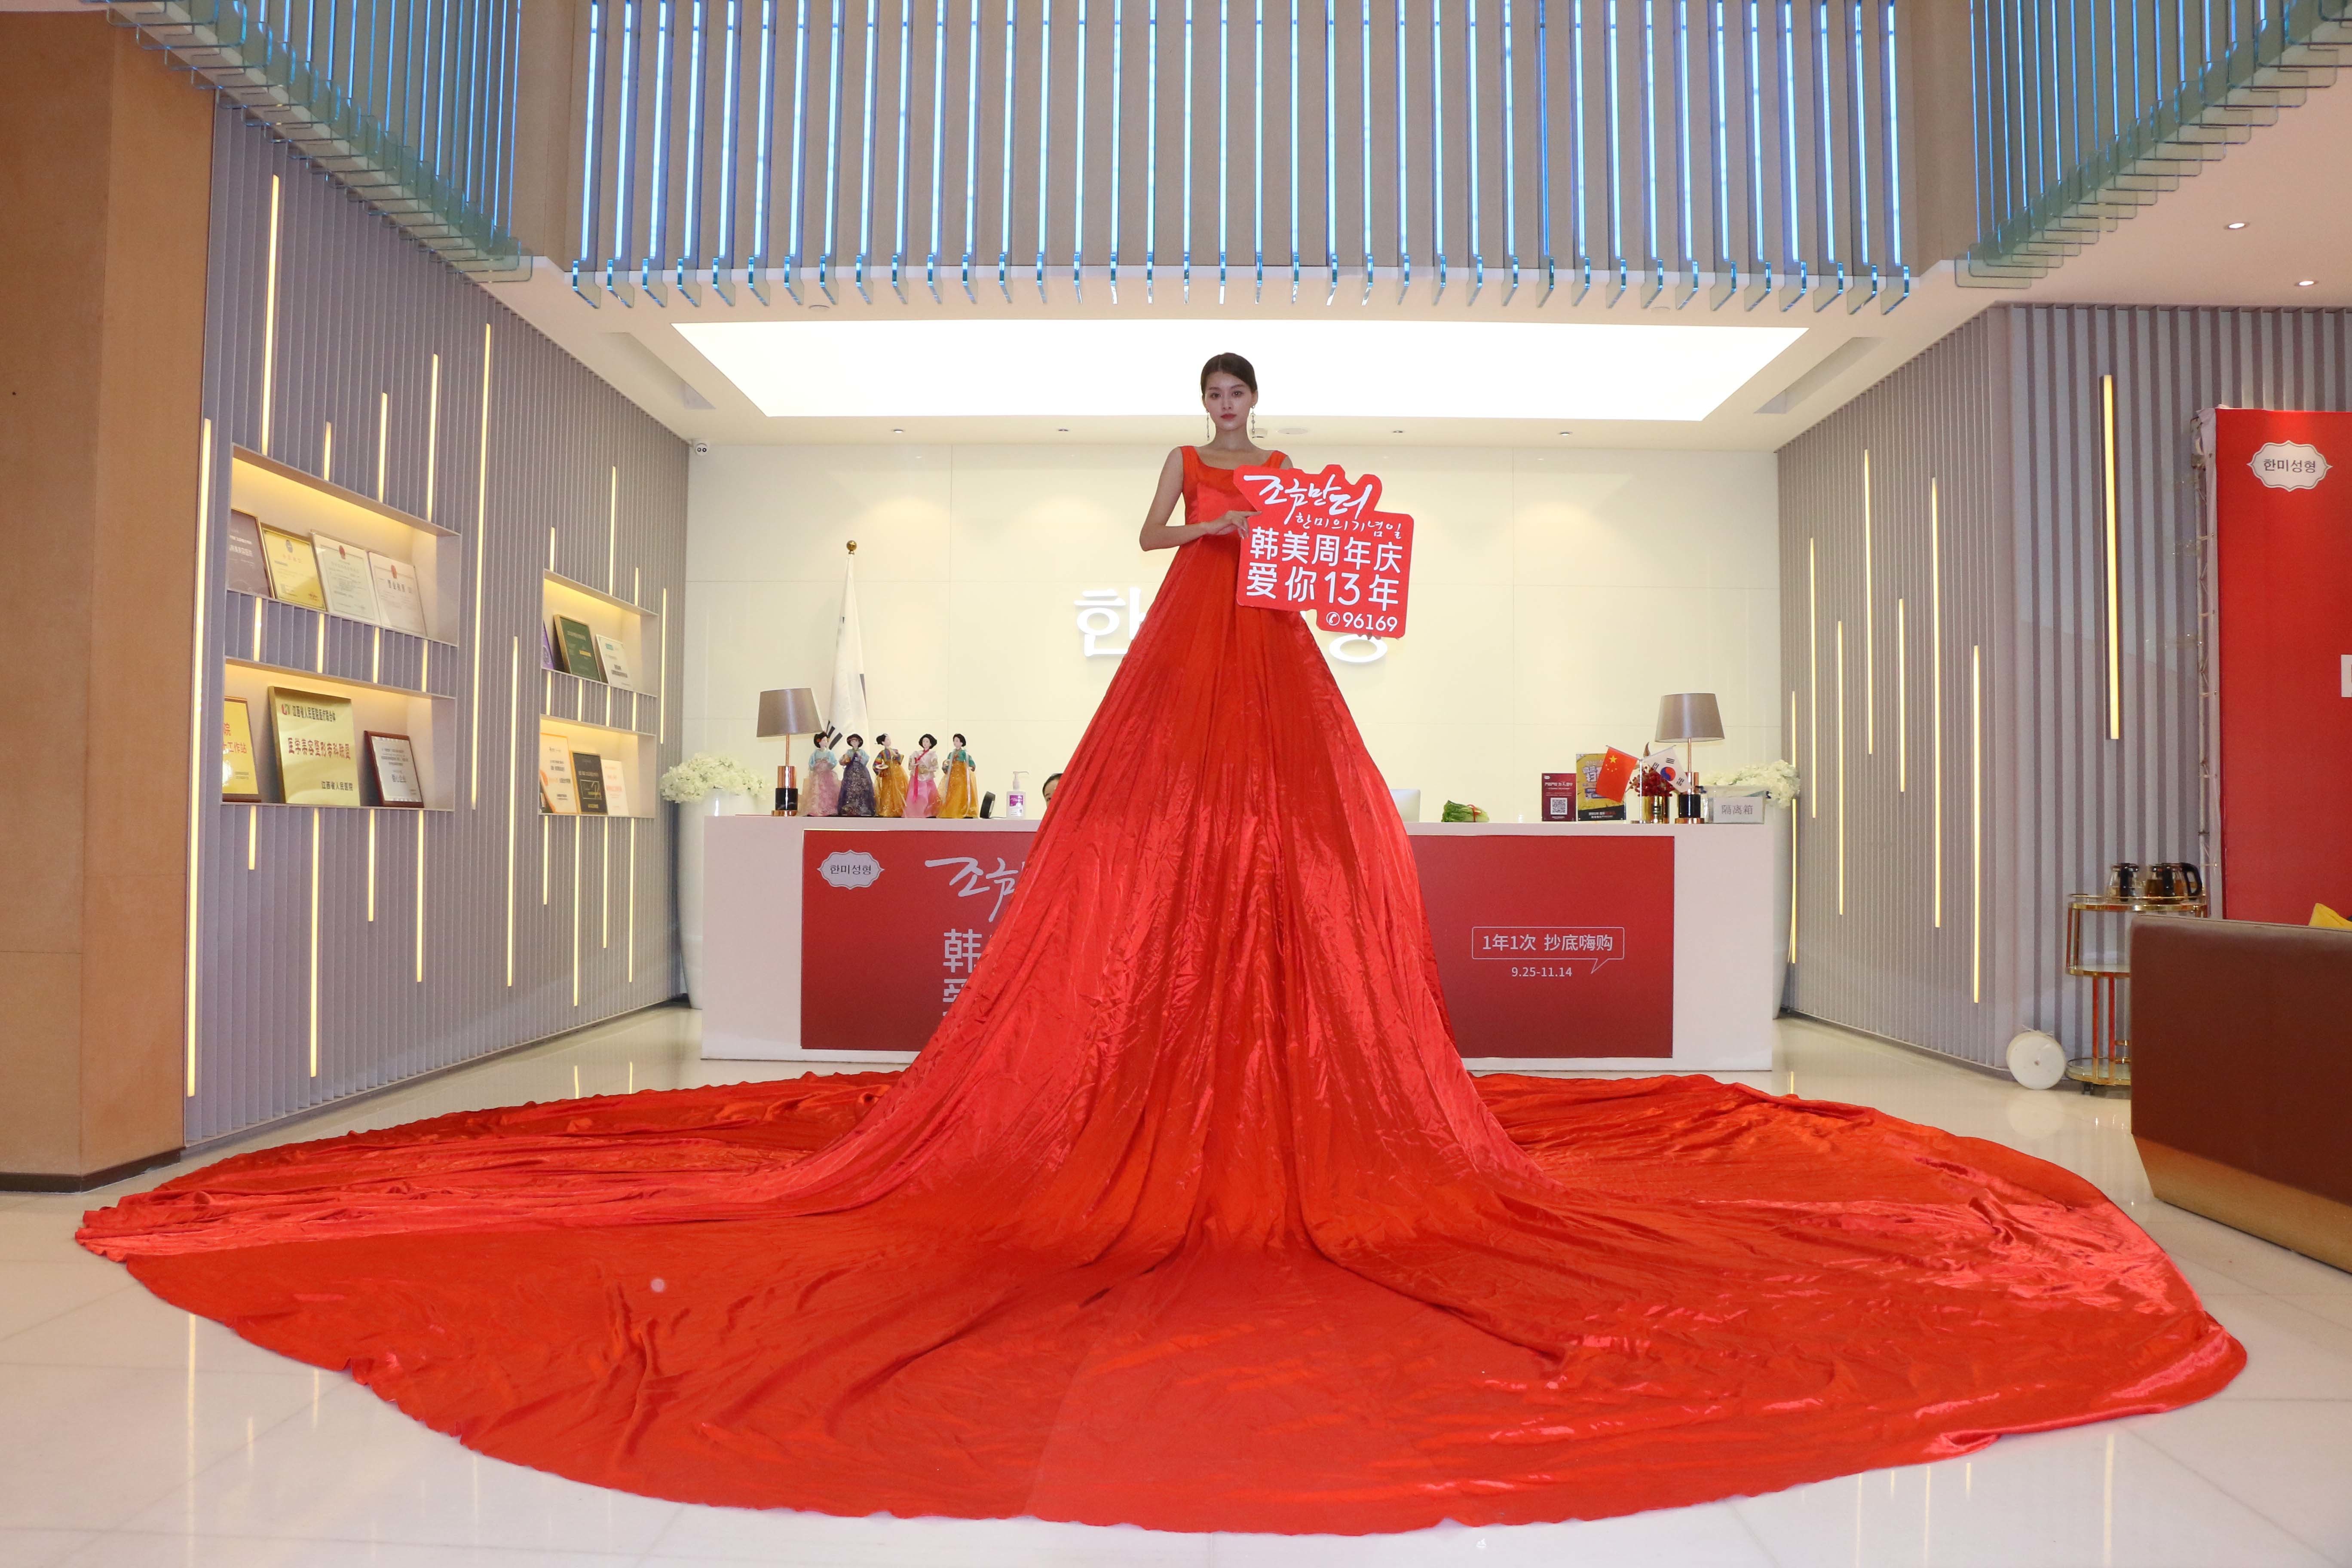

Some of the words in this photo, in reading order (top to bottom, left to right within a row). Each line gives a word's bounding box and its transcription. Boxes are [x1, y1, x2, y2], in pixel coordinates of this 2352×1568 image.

[2263, 459, 2316, 473] 한미성형
[1249, 526, 1403, 573] 韩美周年庆
[1246, 562, 1399, 612] 爱你13年
[1341, 611, 1399, 632] 96169
[1721, 805, 1753, 815] 隔离箱
[830, 864, 871, 875] 한미성형
[1482, 934, 1536, 952] 1年1次
[1544, 934, 1613, 952] 抄底嗨购
[1511, 966, 1573, 977] 9.25-11.14
